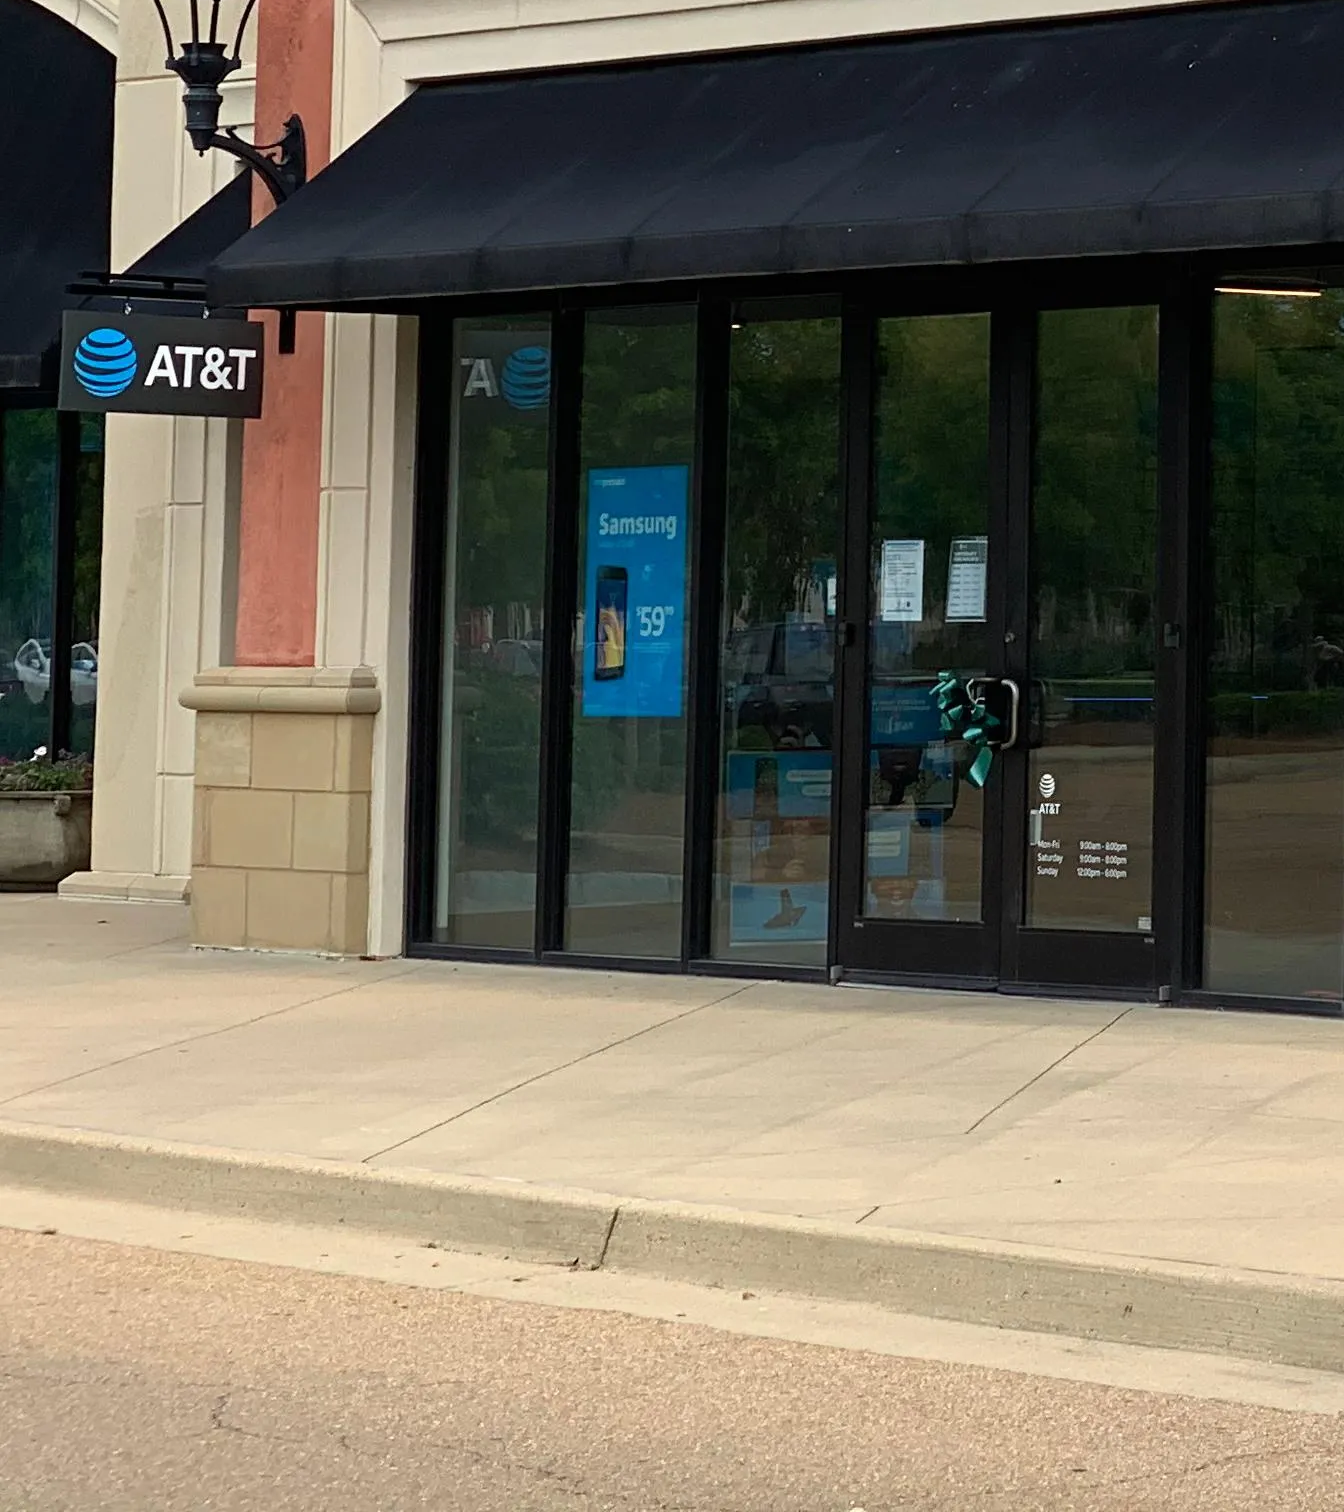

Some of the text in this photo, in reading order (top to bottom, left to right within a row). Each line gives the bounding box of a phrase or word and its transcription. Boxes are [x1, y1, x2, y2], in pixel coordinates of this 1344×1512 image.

[144, 345, 257, 390] AT&T
[599, 512, 677, 539] Samsung
[1039, 804, 1060, 814] AT&T
[1037, 840, 1060, 849] Mon-Fri
[1037, 853, 1063, 863] Saturday
[1037, 866, 1058, 877] Sunday
